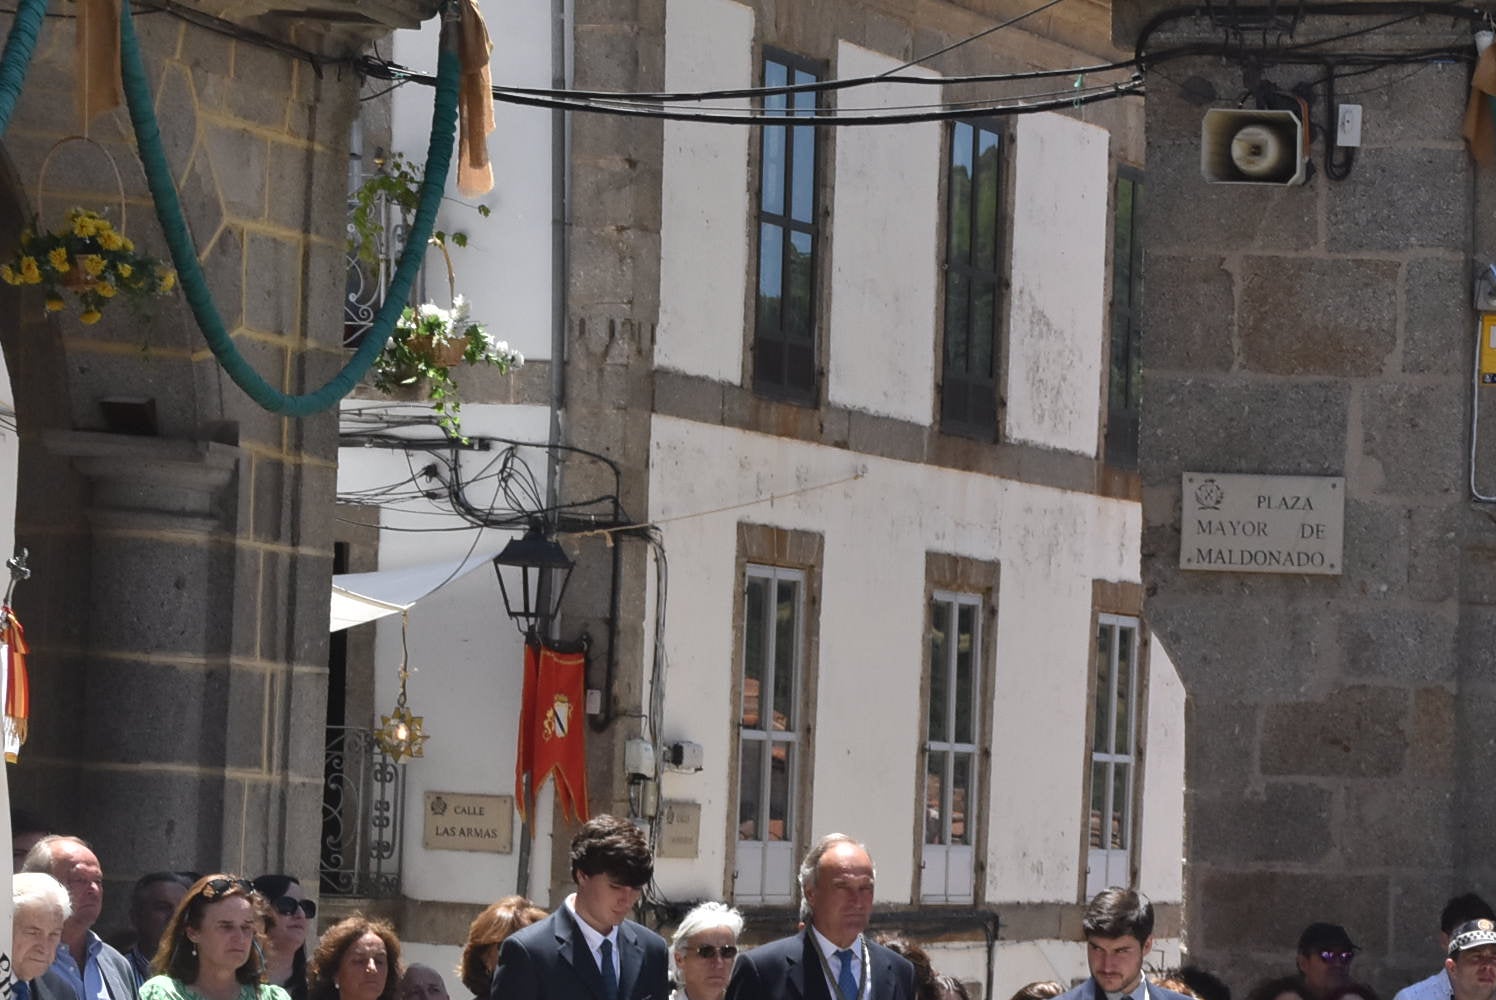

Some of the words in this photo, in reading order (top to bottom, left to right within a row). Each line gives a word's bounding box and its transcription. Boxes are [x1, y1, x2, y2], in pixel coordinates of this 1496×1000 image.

[1257, 495, 1314, 511] PLAZA
[1197, 519, 1269, 537] MAYOR
[1300, 523, 1327, 539] DE
[1196, 548, 1326, 567] MALDONADO
[454, 806, 485, 816] CALLE
[435, 825, 457, 837] LAS
[459, 827, 498, 839] ARMAS
